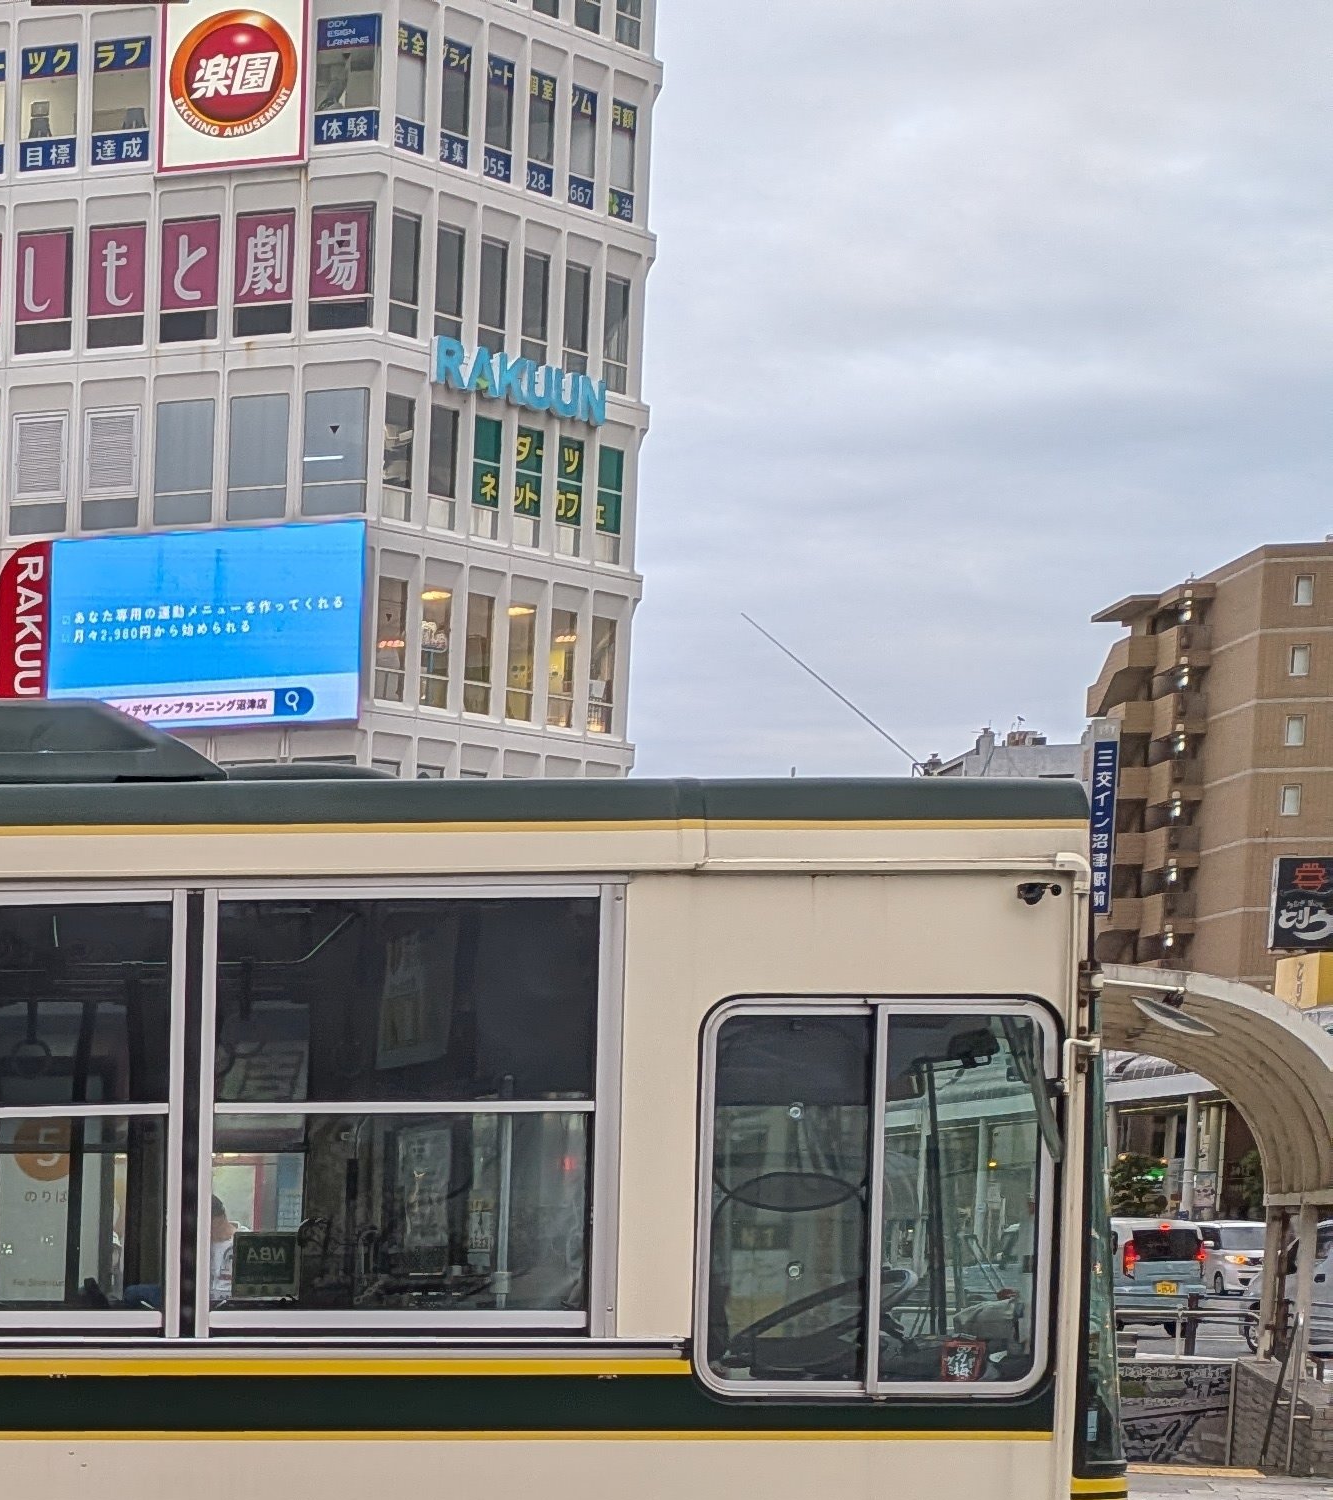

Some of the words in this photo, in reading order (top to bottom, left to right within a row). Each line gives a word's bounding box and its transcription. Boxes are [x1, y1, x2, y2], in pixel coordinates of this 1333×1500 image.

[190, 51, 279, 100] 楽園
[174, 97, 220, 136] EXCITING
[223, 88, 291, 137] AMUSEMENT
[430, 334, 608, 427] RAKUUN
